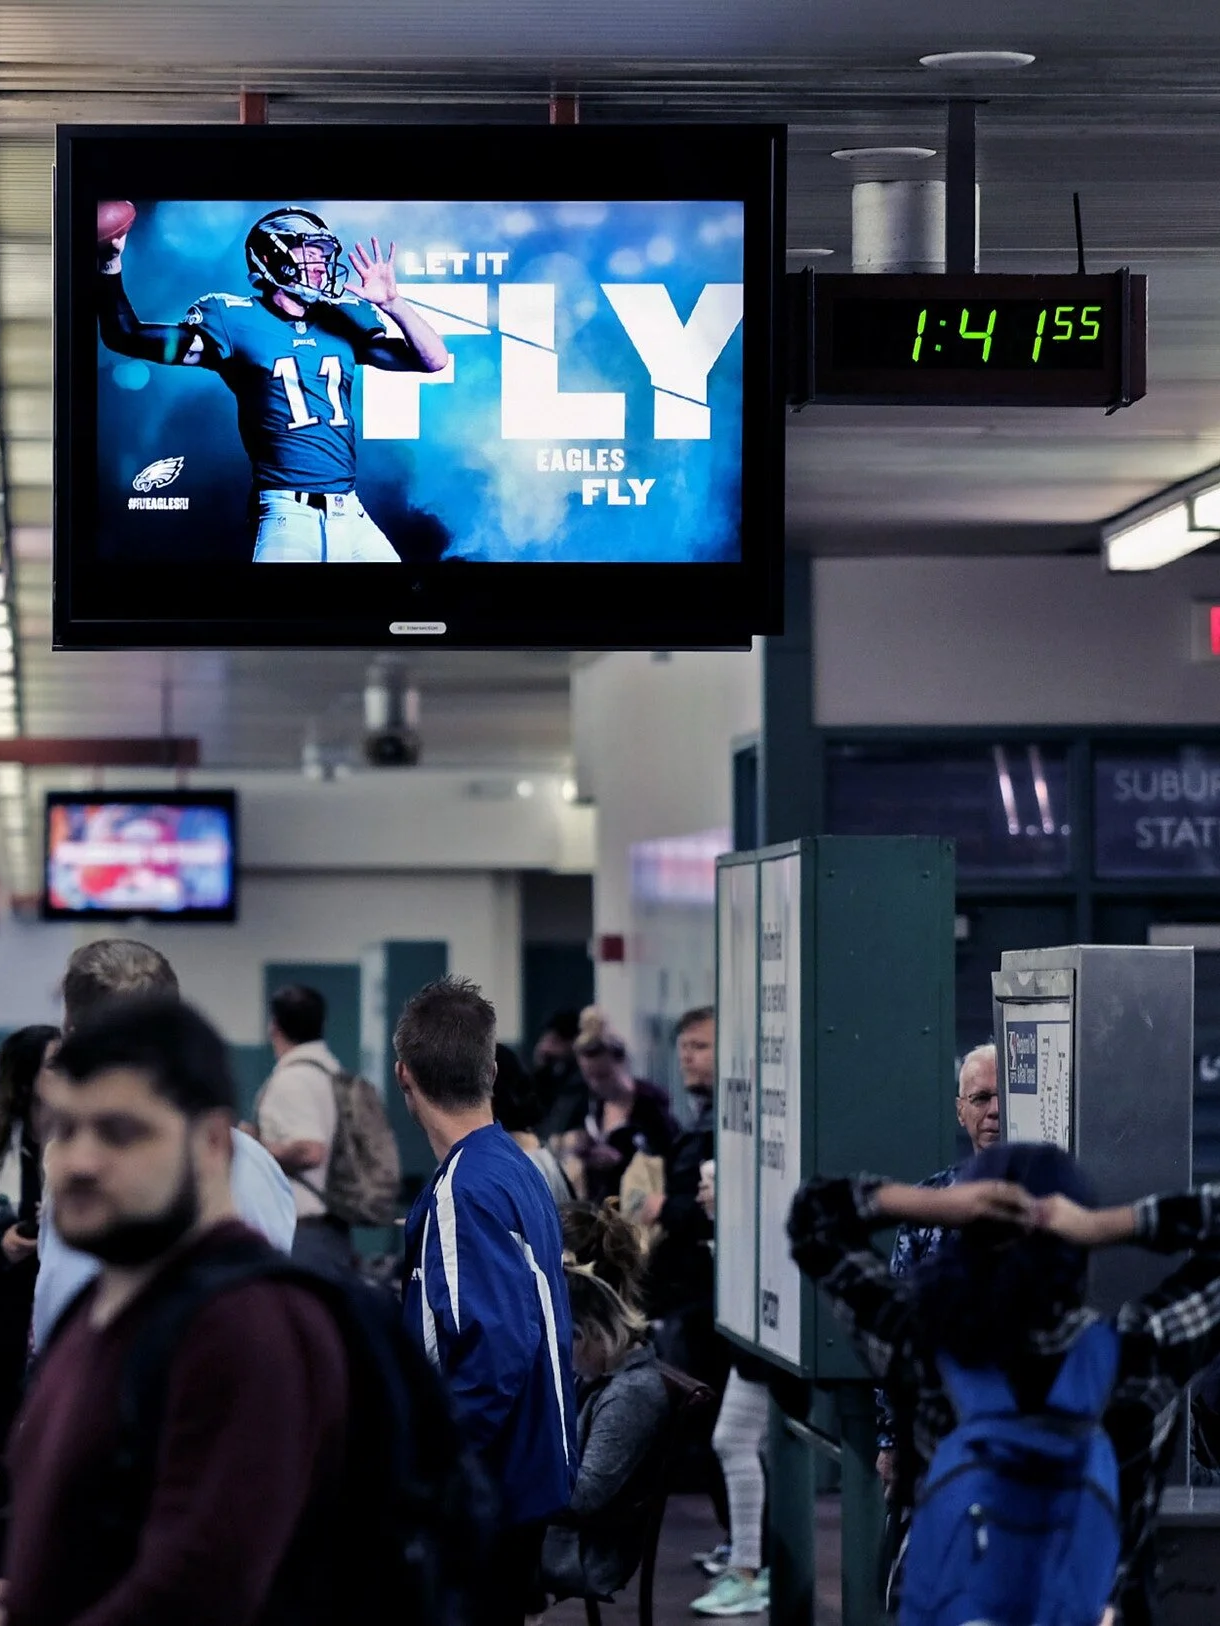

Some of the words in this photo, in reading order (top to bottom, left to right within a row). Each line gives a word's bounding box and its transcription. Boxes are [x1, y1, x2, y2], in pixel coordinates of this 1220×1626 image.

[405, 252, 470, 275] LET
[476, 252, 509, 275] IT
[912, 309, 1046, 362] 1:41
[1053, 307, 1101, 340] 55
[362, 283, 744, 440] FLY
[272, 356, 349, 430] 11
[536, 448, 625, 472] EAGLES
[581, 478, 656, 506] FLY
